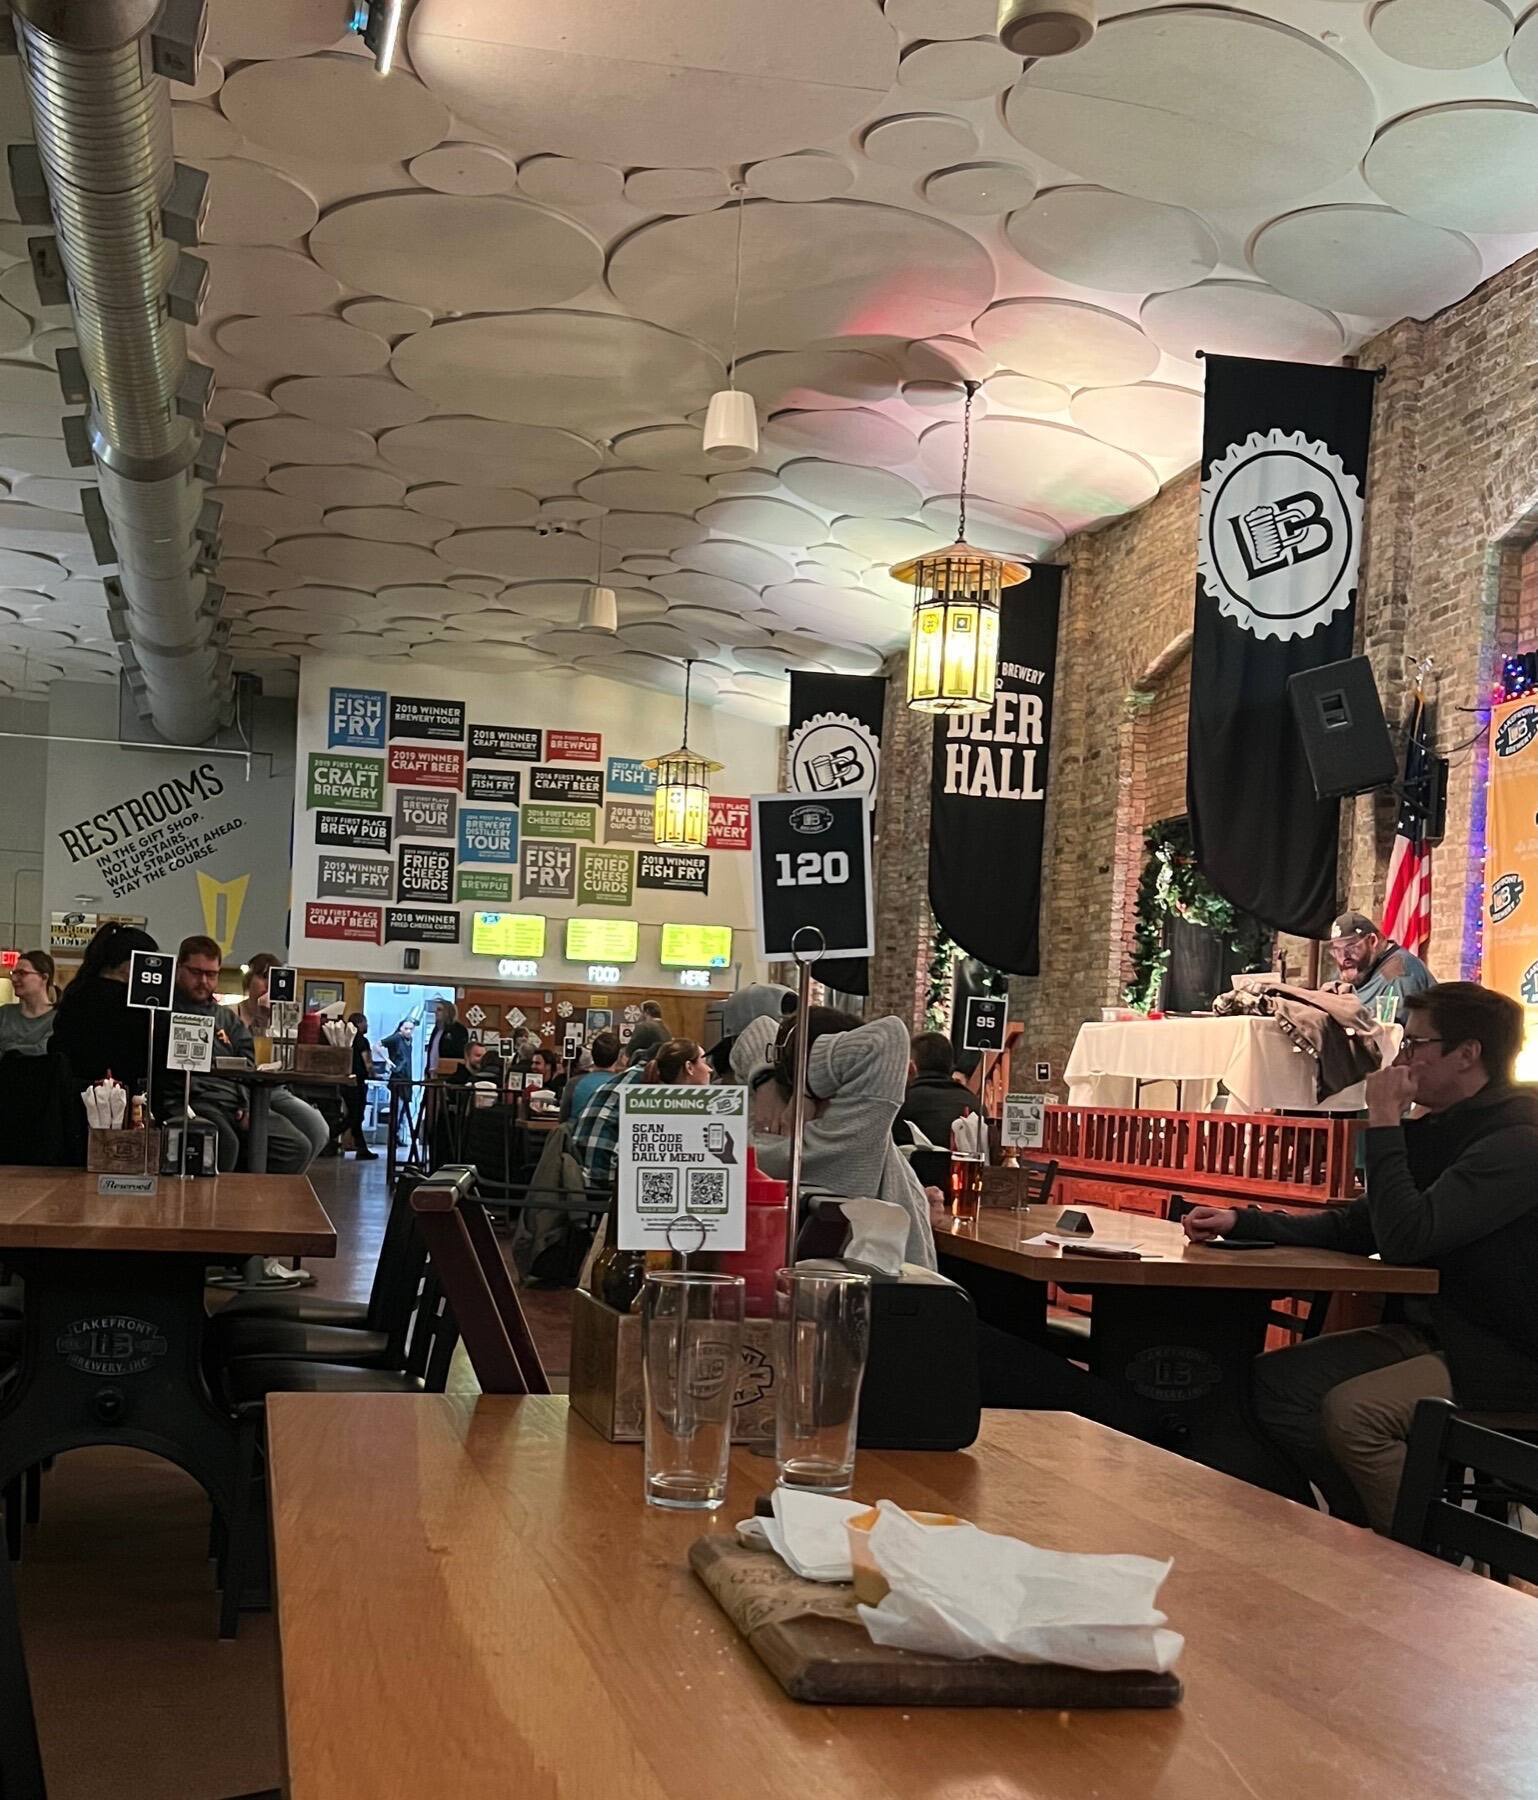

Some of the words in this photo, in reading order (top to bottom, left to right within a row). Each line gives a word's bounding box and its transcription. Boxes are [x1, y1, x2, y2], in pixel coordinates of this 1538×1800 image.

[1001, 662, 1045, 685] BREWERY
[334, 698, 381, 717] FISH
[395, 704, 418, 714] 2018
[420, 706, 461, 717] WINNER
[334, 715, 381, 736] FRY
[395, 713, 435, 724] BREWERY
[436, 716, 460, 725] TOUR
[473, 730, 496, 739] 2018
[498, 732, 538, 742] WINNER
[473, 740, 498, 748] CRAFT
[500, 741, 537, 750] BREWERY
[550, 740, 598, 751] BREWPUB
[393, 751, 416, 760] 2019
[418, 753, 459, 763] WINNER
[332, 761, 353, 769] FIRST
[354, 763, 379, 771] PLACE
[391, 760, 429, 772] CRAFT
[431, 763, 459, 774] BEER
[943, 743, 1044, 800] HALL
[314, 767, 379, 787] CRAFT
[554, 773, 575, 781] FIRST
[611, 769, 645, 783] FISH
[314, 783, 378, 800] BREWERY
[472, 779, 494, 789] FISH
[496, 781, 515, 791] FRY
[534, 779, 570, 790] CRAFT
[572, 782, 600, 792] BEER
[402, 801, 449, 811] BREWERY
[611, 807, 632, 816] 2018
[729, 803, 749, 811] PLACE
[58, 763, 224, 864] RESTROOMS
[402, 809, 448, 826] TOUR
[545, 810, 566, 818] FIRST
[567, 811, 591, 819] PLACE
[610, 816, 637, 824] PLACE
[322, 815, 338, 824] 2017
[340, 817, 361, 826] FIRST
[362, 819, 387, 827] PLACE
[466, 820, 512, 831] BREWERY
[527, 816, 560, 826] CHEESE
[562, 818, 591, 827] CURDS
[320, 823, 358, 835] BREW
[361, 826, 387, 838] PUB
[465, 827, 511, 837] DISTILLERY
[97, 856, 112, 868] IN
[113, 843, 138, 859] THE
[138, 829, 164, 848] GIFT
[167, 812, 204, 835] SHOP.
[465, 835, 510, 851] TOUR
[101, 860, 128, 879] NOT
[130, 832, 190, 865] UPSTAIRS.
[106, 868, 142, 889] WALK
[145, 840, 201, 872] STRAIGHT
[203, 818, 247, 844] AHEAD.
[526, 850, 571, 868] FISH
[324, 860, 346, 870] 2019
[348, 863, 390, 874] WINNER
[403, 854, 449, 870] FRIED
[584, 858, 629, 872] FRIED
[642, 855, 664, 865] 2018
[666, 857, 706, 867] WINNER
[112, 881, 141, 899] STAY
[143, 868, 167, 884] THE
[168, 844, 218, 872] COURSE.
[402, 868, 449, 880] CHEESE
[641, 865, 673, 878] FISH
[678, 867, 705, 880] FRY
[775, 851, 849, 886] 120
[323, 870, 356, 884] FISH
[361, 874, 389, 887] FRY
[526, 866, 571, 887] FRY
[584, 870, 628, 882] CHEESE
[402, 877, 449, 891] CURDS
[461, 880, 509, 891] BREWPUB
[583, 880, 628, 893] CURDS
[329, 909, 350, 917] FIRST
[352, 910, 377, 919] PLACE
[391, 912, 413, 922] 2018
[415, 914, 455, 924] WINNER
[309, 915, 347, 926] CRAFT
[350, 917, 378, 929] BEER
[390, 921, 409, 929] FRIED
[410, 922, 433, 930] CHEESE
[498, 959, 538, 977] ORDER
[588, 966, 620, 982] FOOD
[141, 971, 163, 985] 99
[680, 970, 710, 987] HERE
[976, 1016, 996, 1029] 95
[629, 1098, 662, 1109] DAILY
[663, 1099, 705, 1110] DINING
[632, 1124, 664, 1133] SCAN
[632, 1133, 650, 1144] QR
[652, 1134, 683, 1143] CODE
[632, 1143, 655, 1152] FOR
[658, 1143, 683, 1152] OUR
[632, 1153, 666, 1162] DAILY
[669, 1153, 705, 1162] MENU
[104, 1180, 152, 1191] Reserved
[73, 1318, 153, 1335] LAKEFRONT
